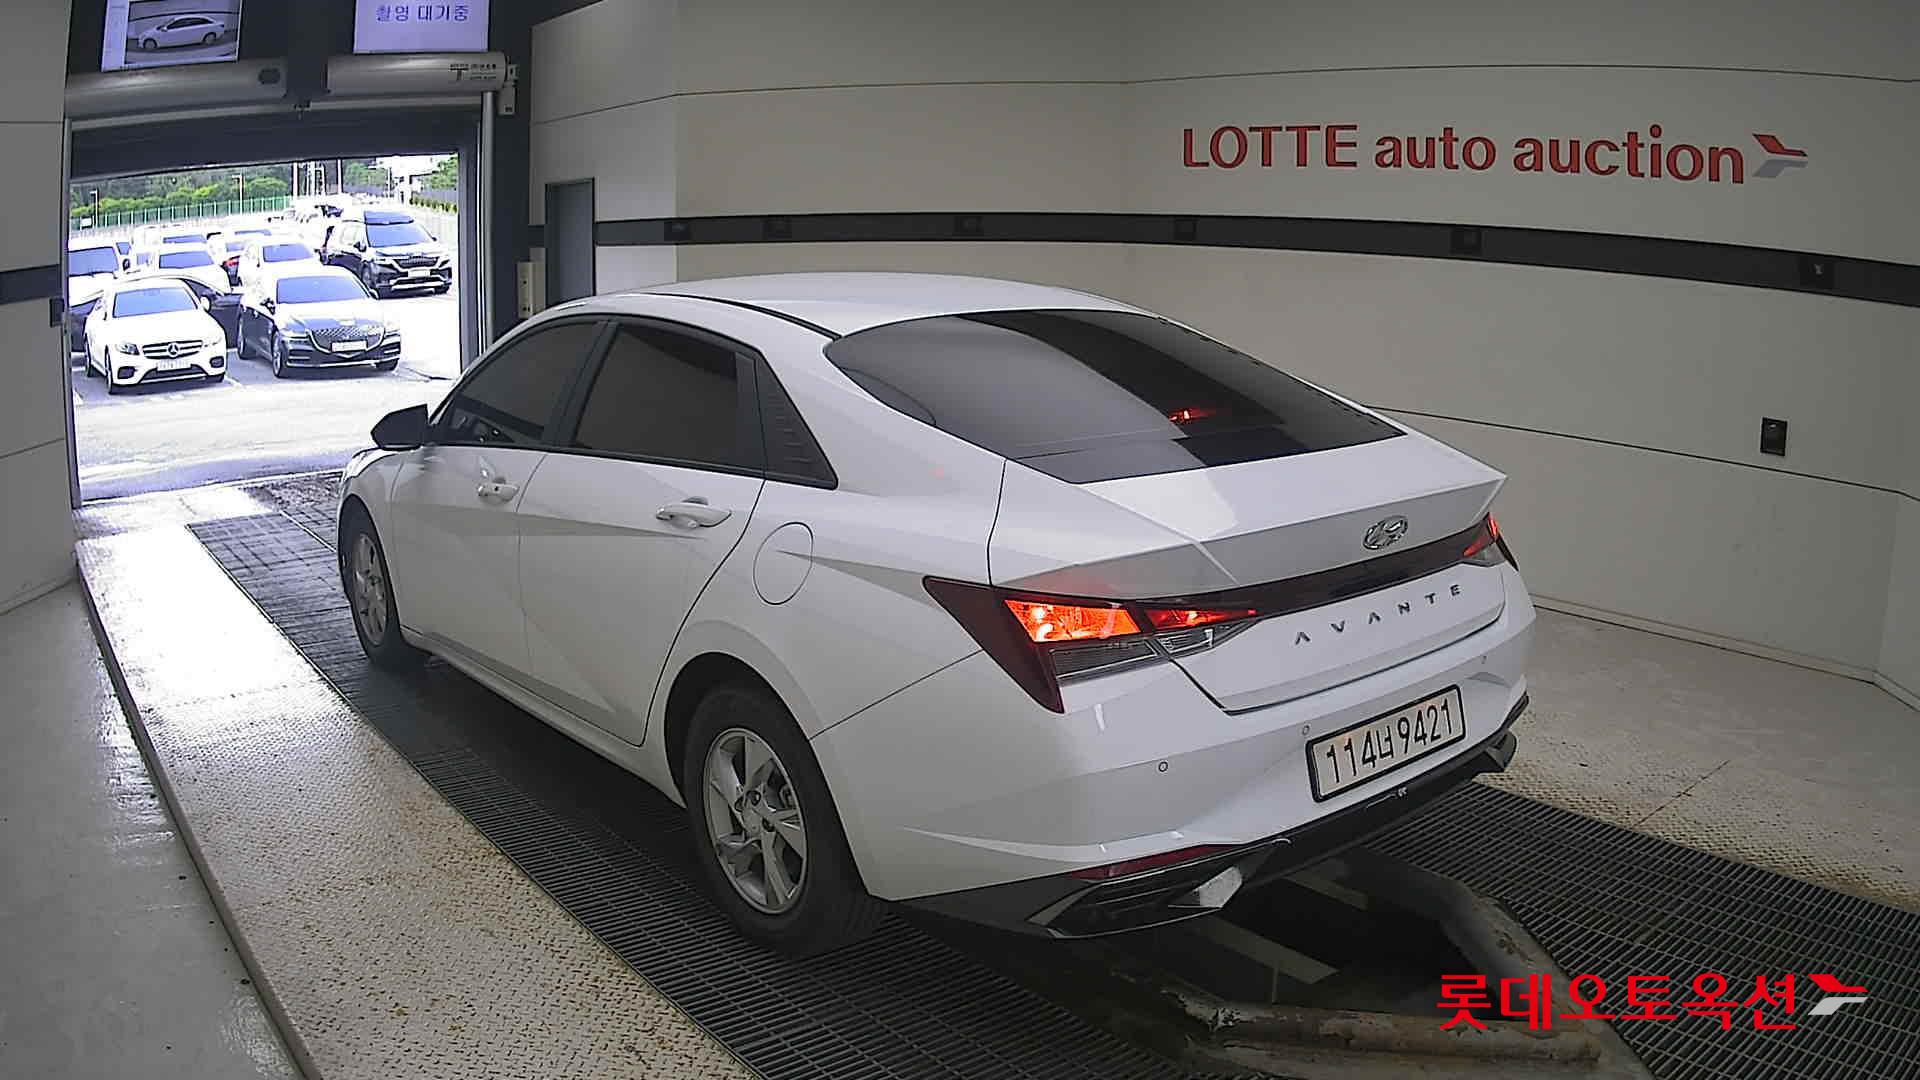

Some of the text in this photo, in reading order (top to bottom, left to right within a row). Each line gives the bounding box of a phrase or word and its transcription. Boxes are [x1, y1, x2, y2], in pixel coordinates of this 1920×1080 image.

[418, 5, 469, 22] 대기중
[1183, 124, 1745, 184] LOTTE auto auction
[1295, 584, 1462, 644] AVANTE
